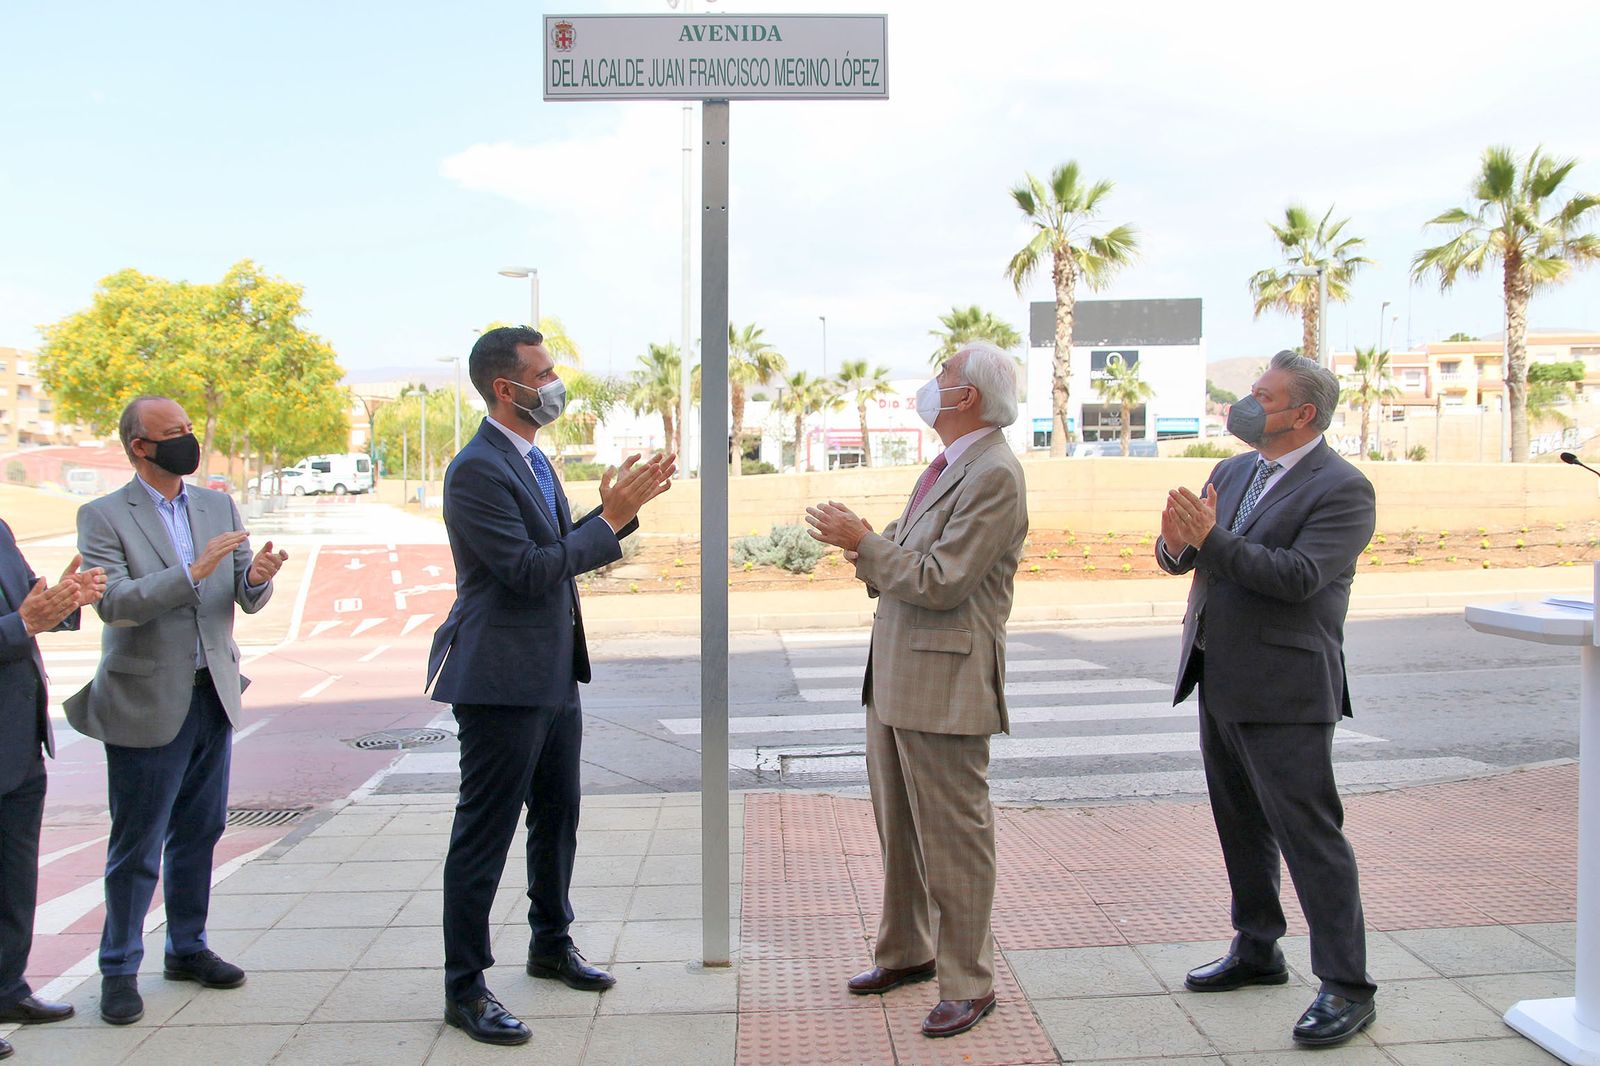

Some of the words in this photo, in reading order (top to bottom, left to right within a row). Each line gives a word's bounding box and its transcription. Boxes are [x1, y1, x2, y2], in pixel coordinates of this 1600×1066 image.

[678, 24, 783, 42] AVENIDA
[552, 59, 579, 87] DEL
[581, 59, 644, 87] ALCALDE
[648, 59, 685, 87] JUAN
[689, 58, 771, 87] FRANCISCO
[775, 58, 830, 87] MEGINO
[834, 50, 880, 87] LÓPEZ
